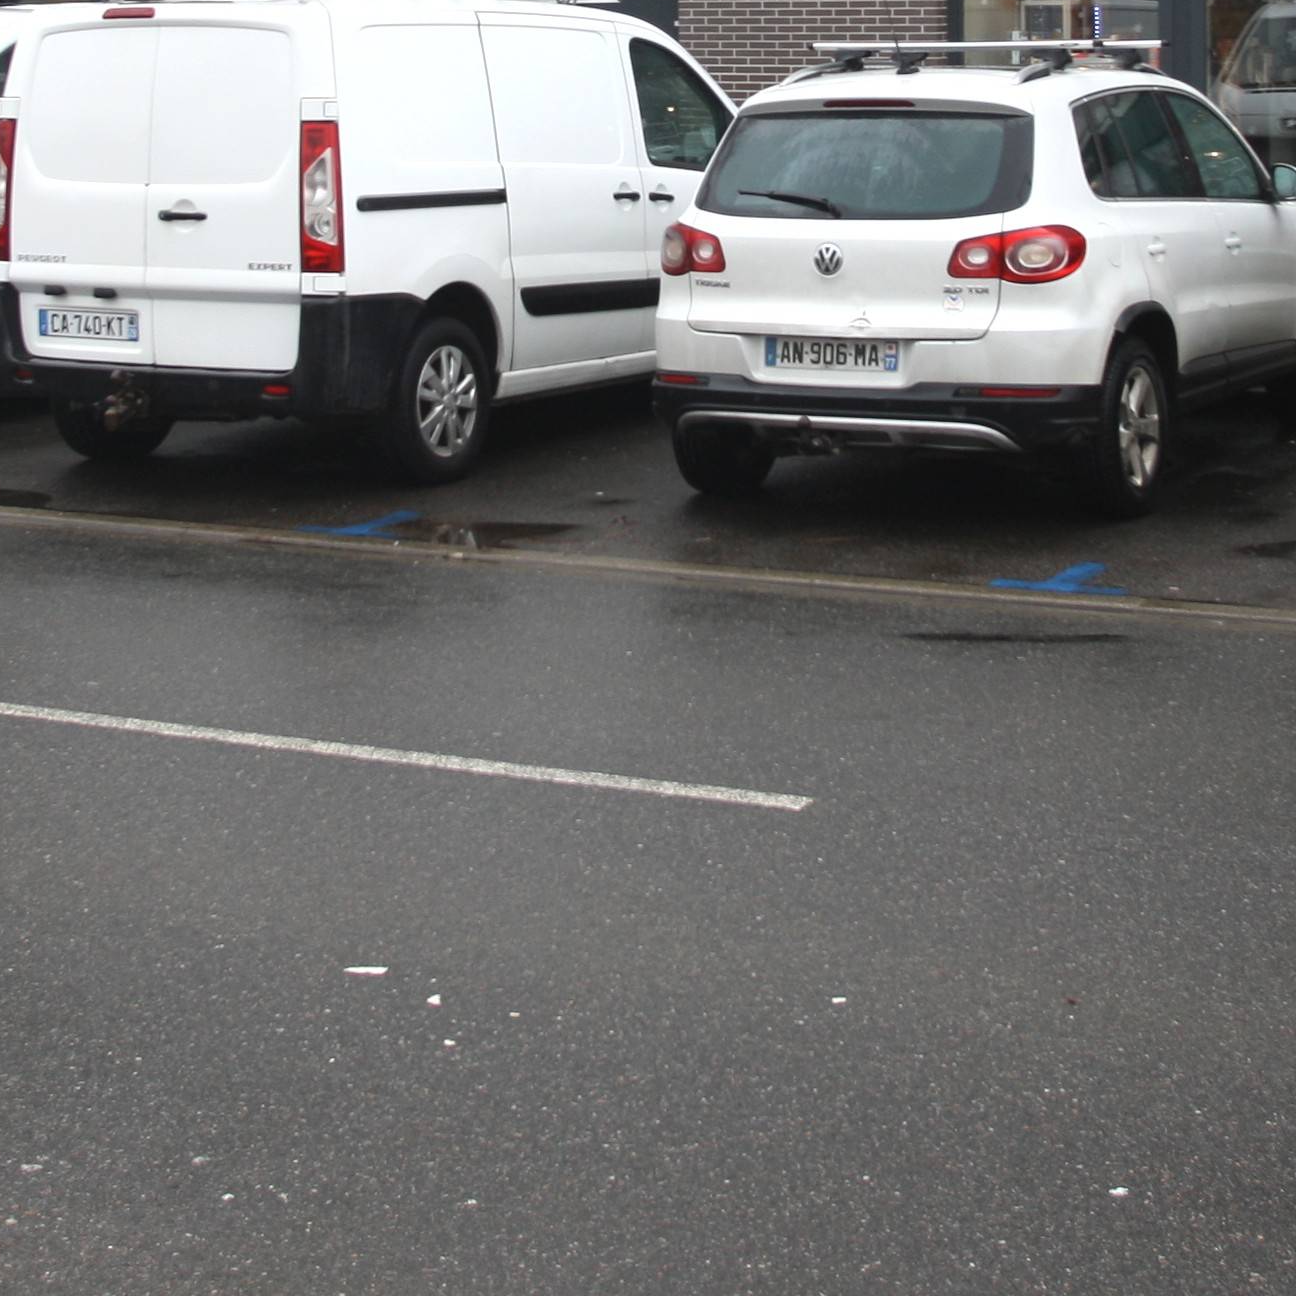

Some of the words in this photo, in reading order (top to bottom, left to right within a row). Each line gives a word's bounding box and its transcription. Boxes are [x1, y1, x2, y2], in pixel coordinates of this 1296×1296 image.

[17, 254, 67, 264] PEUGEOT
[247, 262, 293, 272] EXPERT
[50, 313, 125, 337] CA-740-KT
[779, 340, 880, 368] AN-906-MA
[884, 356, 896, 369] 77
